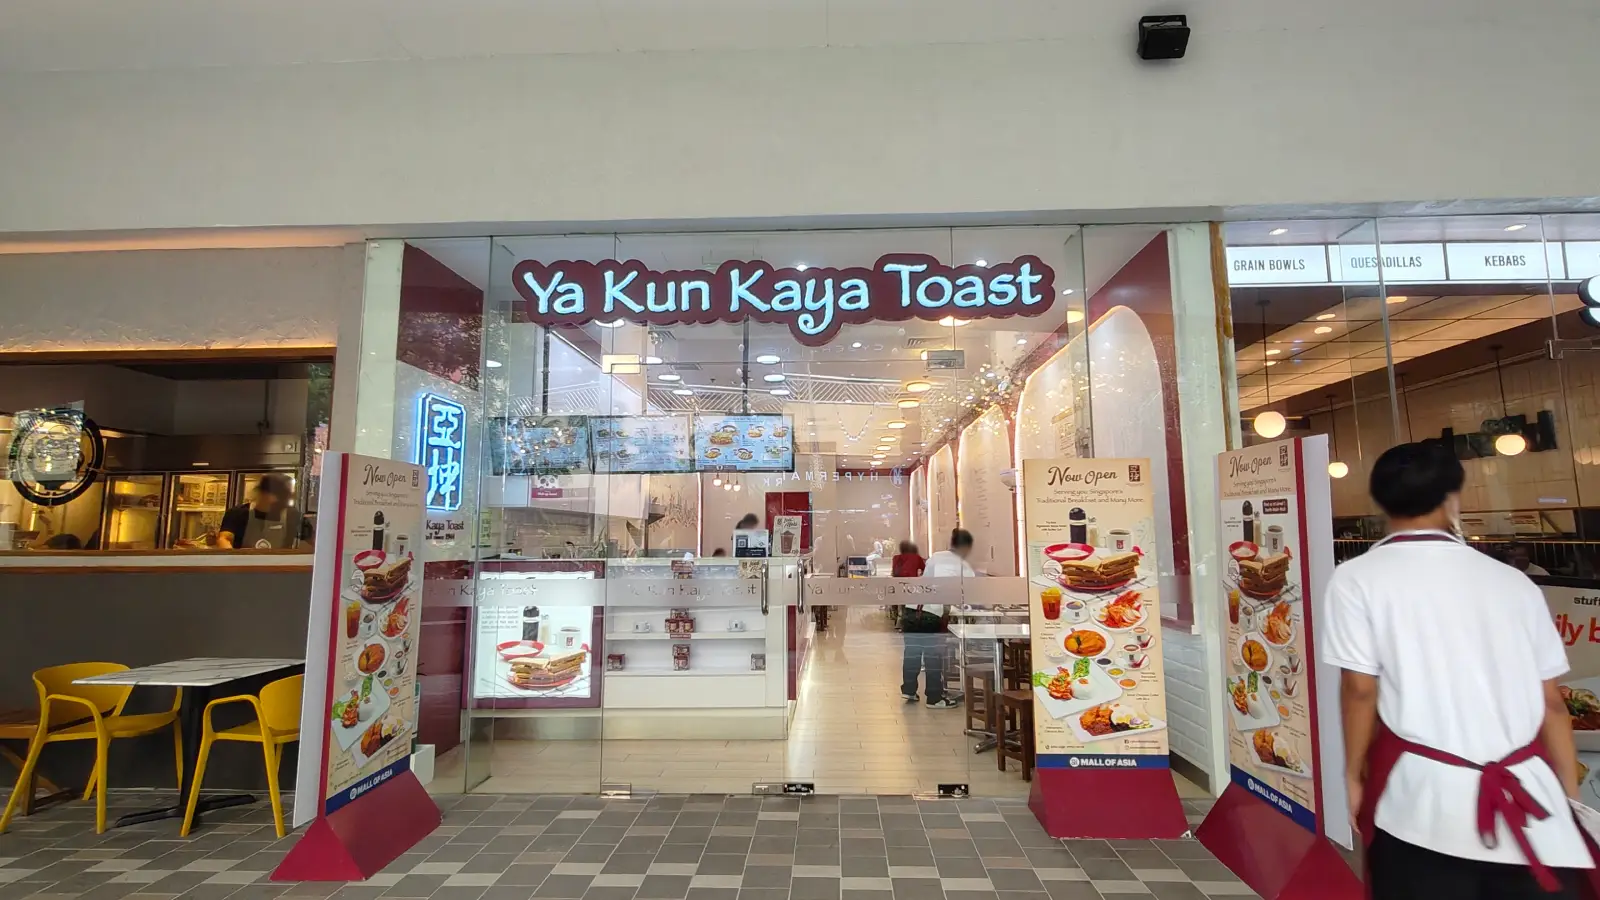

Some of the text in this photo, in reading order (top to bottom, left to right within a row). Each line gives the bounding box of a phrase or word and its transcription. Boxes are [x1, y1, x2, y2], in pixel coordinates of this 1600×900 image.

[1233, 258, 1306, 271] GRAIN BOWLS
[1484, 255, 1526, 267] KEBABS
[523, 263, 1043, 337] Ya Kun Kaya Toast
[1229, 455, 1250, 478] Now
[1251, 456, 1272, 475] Open
[363, 464, 386, 486] Now
[386, 471, 407, 489] Open
[1047, 466, 1118, 487] Now Open
[426, 519, 465, 536] Kaya Toast
[1080, 758, 1104, 767] MALL
[1105, 758, 1116, 767] OF
[1116, 758, 1137, 767] ASIA
[357, 779, 373, 795] MALL
